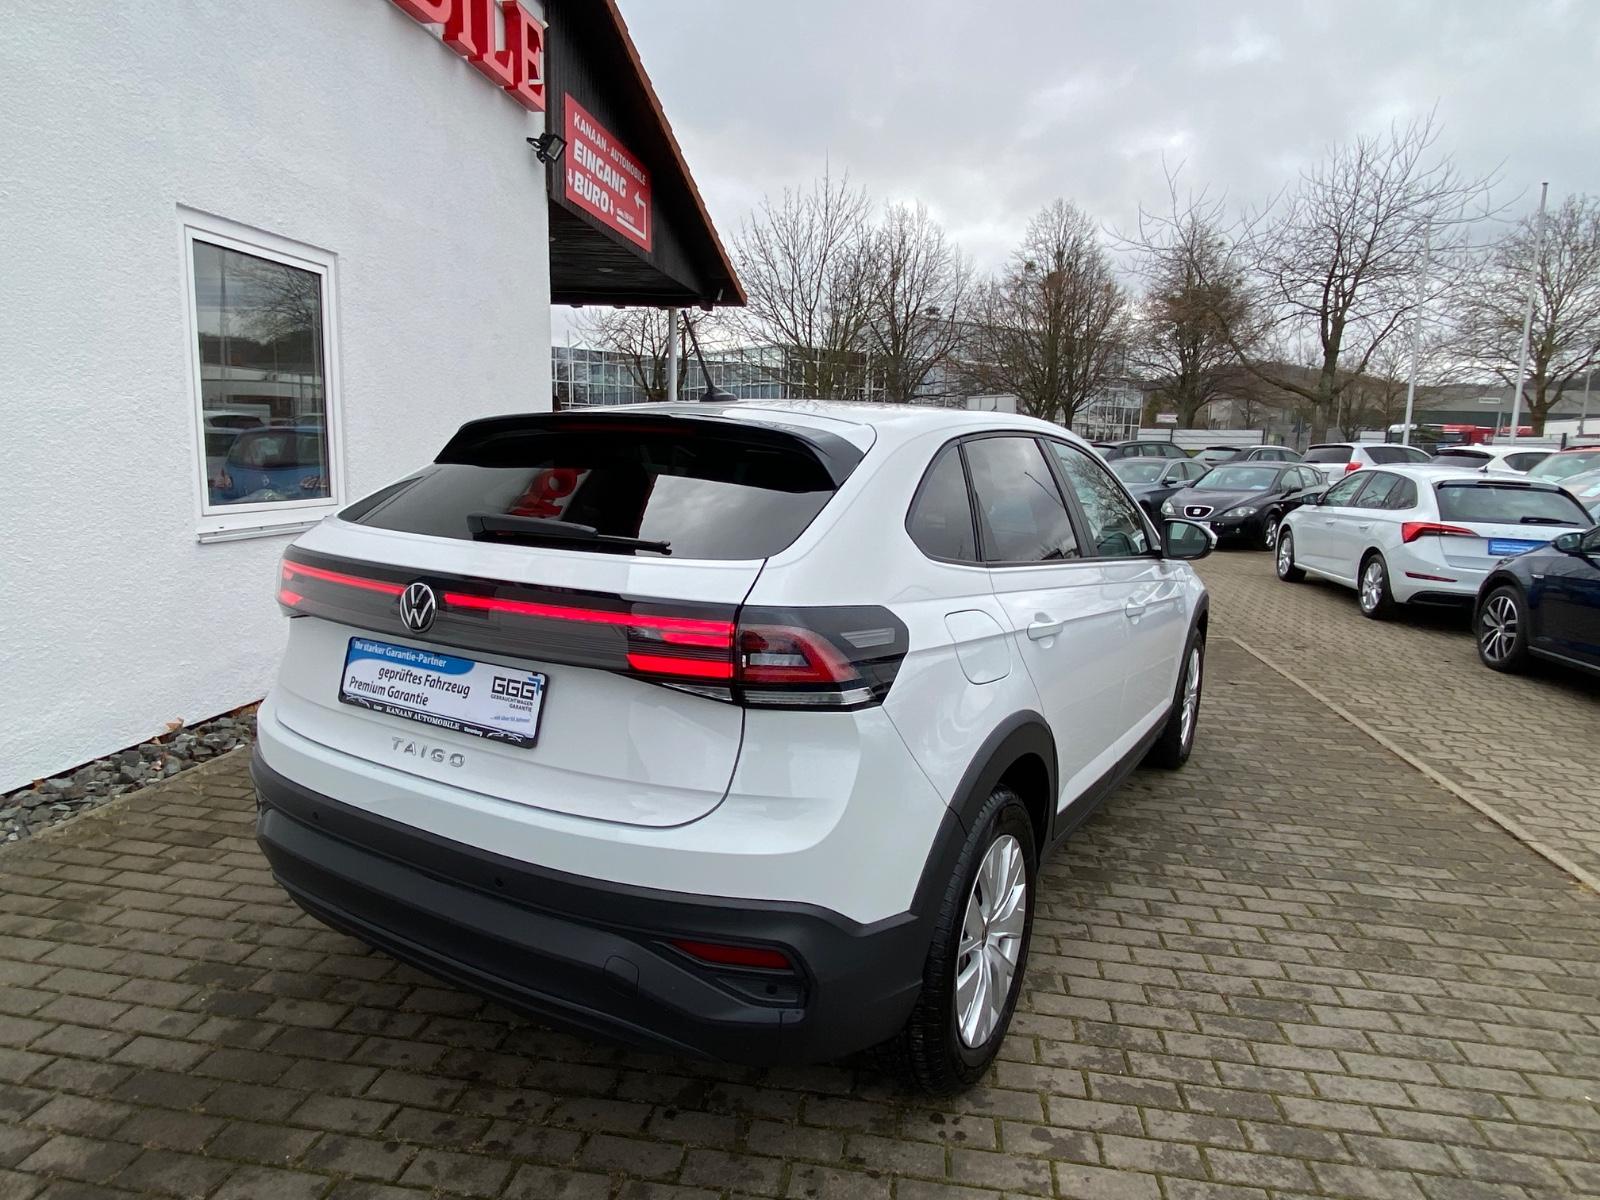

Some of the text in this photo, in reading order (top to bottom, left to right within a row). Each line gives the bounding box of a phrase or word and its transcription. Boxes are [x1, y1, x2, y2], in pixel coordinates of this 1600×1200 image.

[389, 0, 546, 112] ILE
[574, 112, 607, 152] KANAAN
[610, 147, 646, 186] AUTOMOBILE
[574, 138, 627, 198] EINGANG
[574, 171, 609, 213] BÜRO
[363, 643, 385, 654] starker
[386, 647, 447, 668] Garantie-Partner
[349, 676, 429, 706] Premium Garantie
[378, 667, 471, 699] geprüftes Fahrzeug
[491, 675, 536, 701] GGG
[490, 693, 533, 707] GEBRAUCHTWAGEN
[509, 703, 532, 712] GARANTIE
[386, 705, 413, 718] KANAAN
[413, 712, 460, 730] AUTOMOBILE
[392, 736, 465, 768] TAIGO
